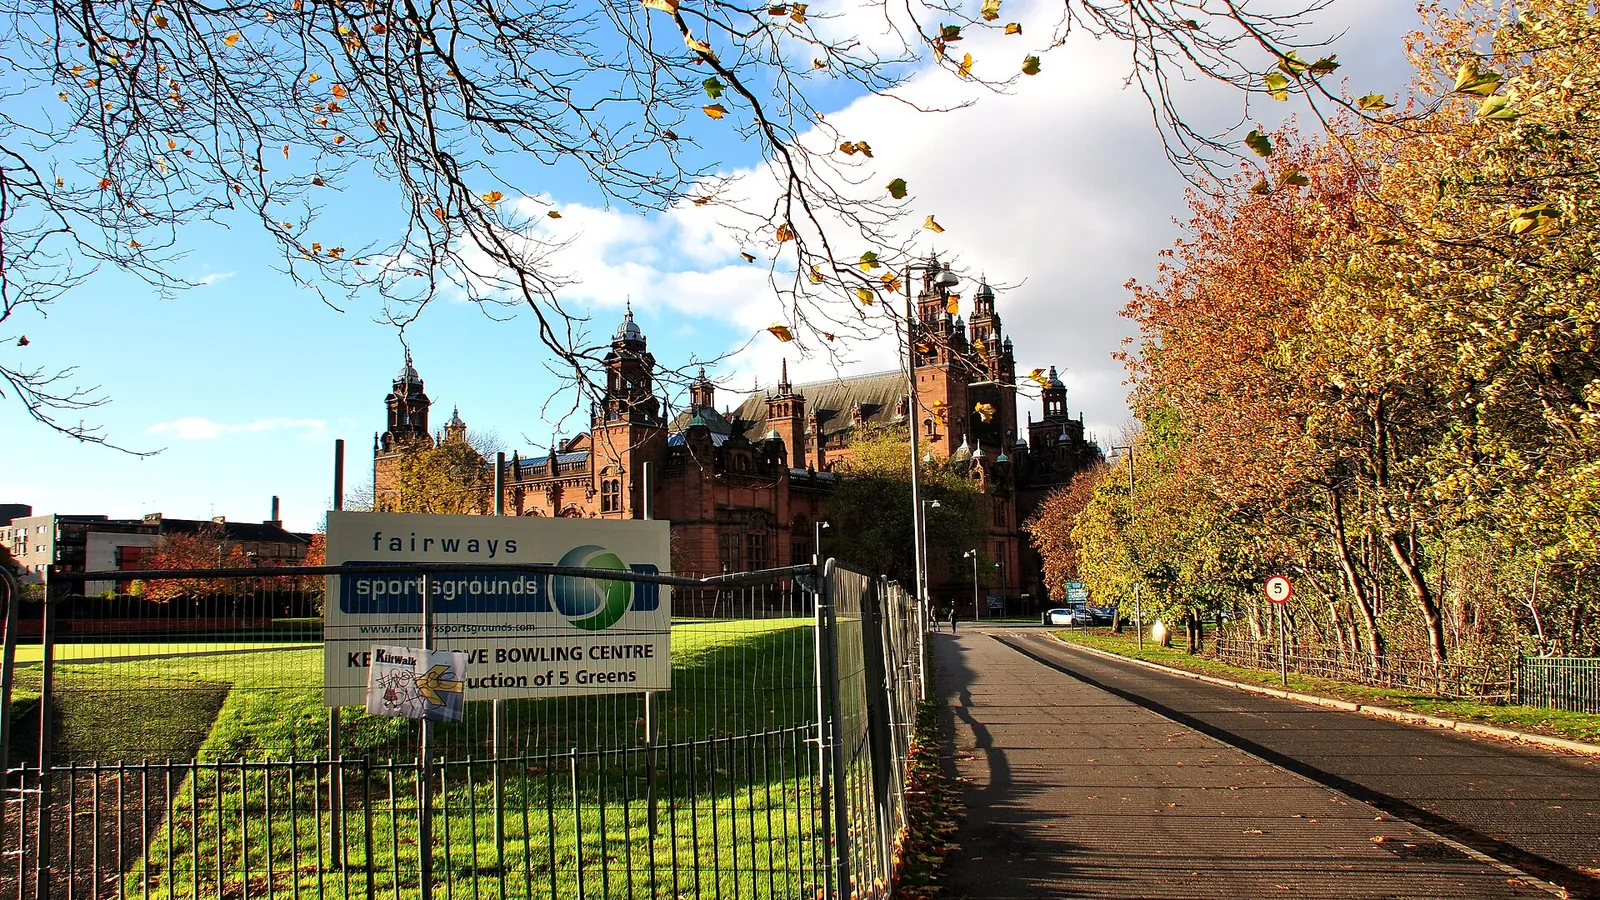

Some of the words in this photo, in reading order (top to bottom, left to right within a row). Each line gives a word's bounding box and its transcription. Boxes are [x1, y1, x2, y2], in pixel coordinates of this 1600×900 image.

[372, 531, 518, 558] fairways
[356, 576, 538, 600] sportsgrounds
[1274, 583, 1282, 594] 5
[360, 622, 535, 635] www.fairwssportsgrounds.com
[495, 647, 583, 665] BOWLING
[588, 644, 654, 660] CENTRE
[466, 672, 527, 689] uction
[533, 670, 554, 687] of
[559, 670, 570, 686] 5
[575, 669, 637, 685] Greens
